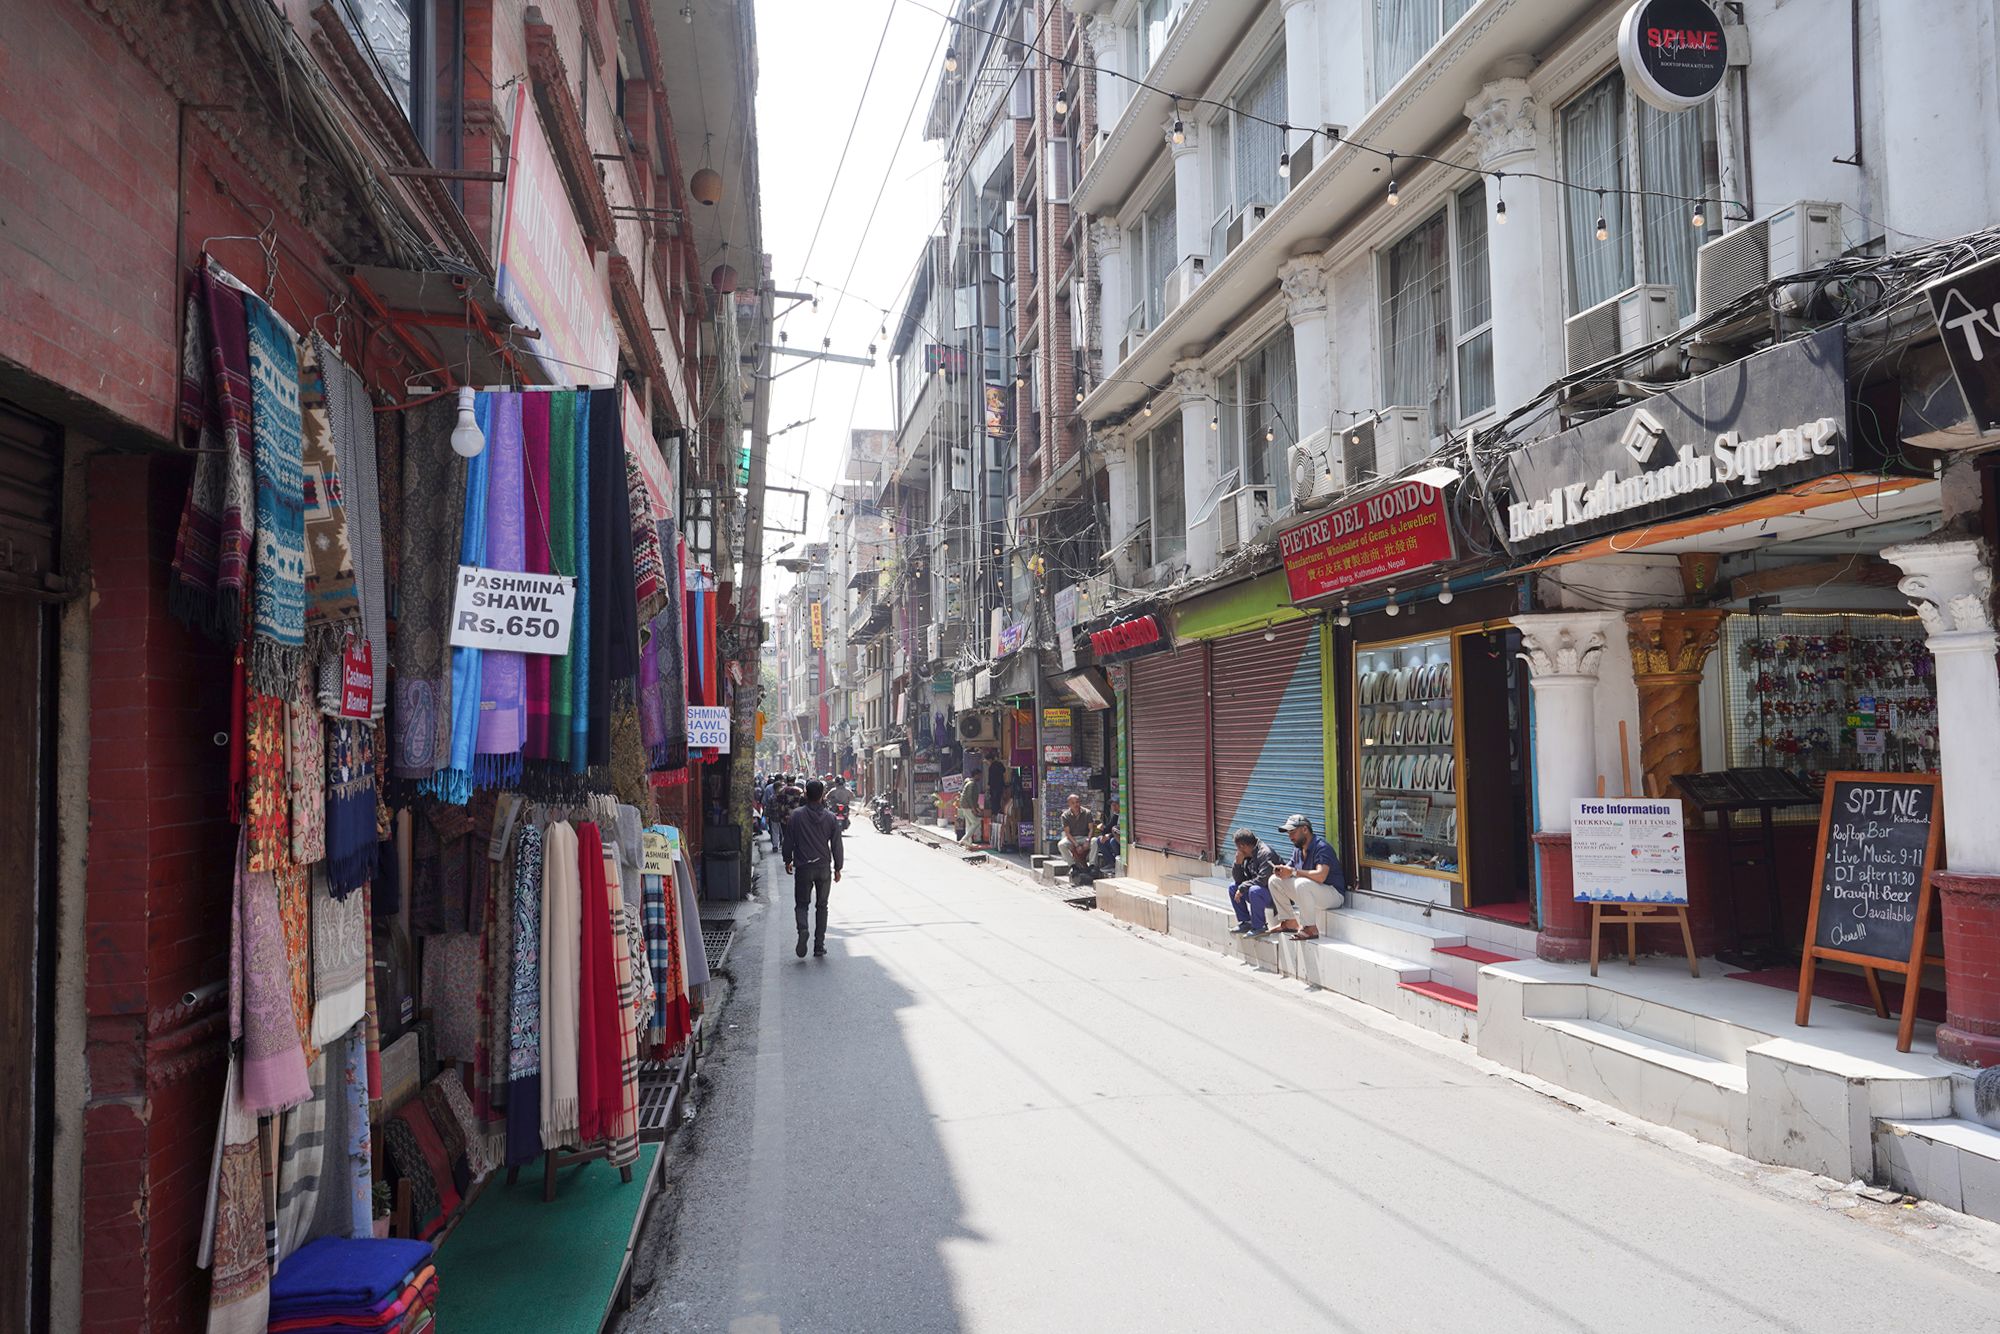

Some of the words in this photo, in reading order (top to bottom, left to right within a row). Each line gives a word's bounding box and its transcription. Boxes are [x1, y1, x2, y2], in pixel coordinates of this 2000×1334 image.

[1647, 27, 1719, 51] SPINE
[1508, 487, 1564, 543] Hotel
[1564, 444, 1713, 525] Kathmandu
[1714, 417, 1837, 486] Square
[1280, 519, 1332, 557] PIETRE
[1332, 506, 1365, 538] DEL
[1367, 484, 1436, 525] MONDO
[1286, 551, 1326, 571] Manufacturer,
[1326, 537, 1360, 557] Wholesaler
[1360, 533, 1368, 545] of
[1368, 528, 1390, 541] Gems
[1390, 524, 1397, 535] &
[1398, 511, 1438, 534] Jewellery
[1354, 565, 1388, 580] Kathmandu,
[1388, 558, 1406, 571] Nepal
[463, 574, 566, 596] PASHMINA
[472, 592, 553, 613] SHAWL
[458, 610, 560, 639] Rs.650
[687, 708, 728, 720] SHMINA
[687, 720, 725, 730] HAWL
[1581, 804, 1604, 814] Free
[1606, 803, 1671, 815] Information
[1844, 788, 1922, 816] SPINE
[1833, 823, 1866, 849] Rooftop
[1867, 820, 1894, 839] Bar
[645, 850, 671, 859] ASHMERE
[1834, 843, 1860, 865] Live
[1863, 844, 1897, 865] Music
[1899, 848, 1923, 867] 9-11
[1835, 865, 1854, 882] DJ
[1858, 865, 1886, 883] after
[1888, 870, 1916, 886] 11:30
[1833, 882, 1880, 919] Draught
[1881, 885, 1912, 903] Beer
[1869, 904, 1914, 922] available
